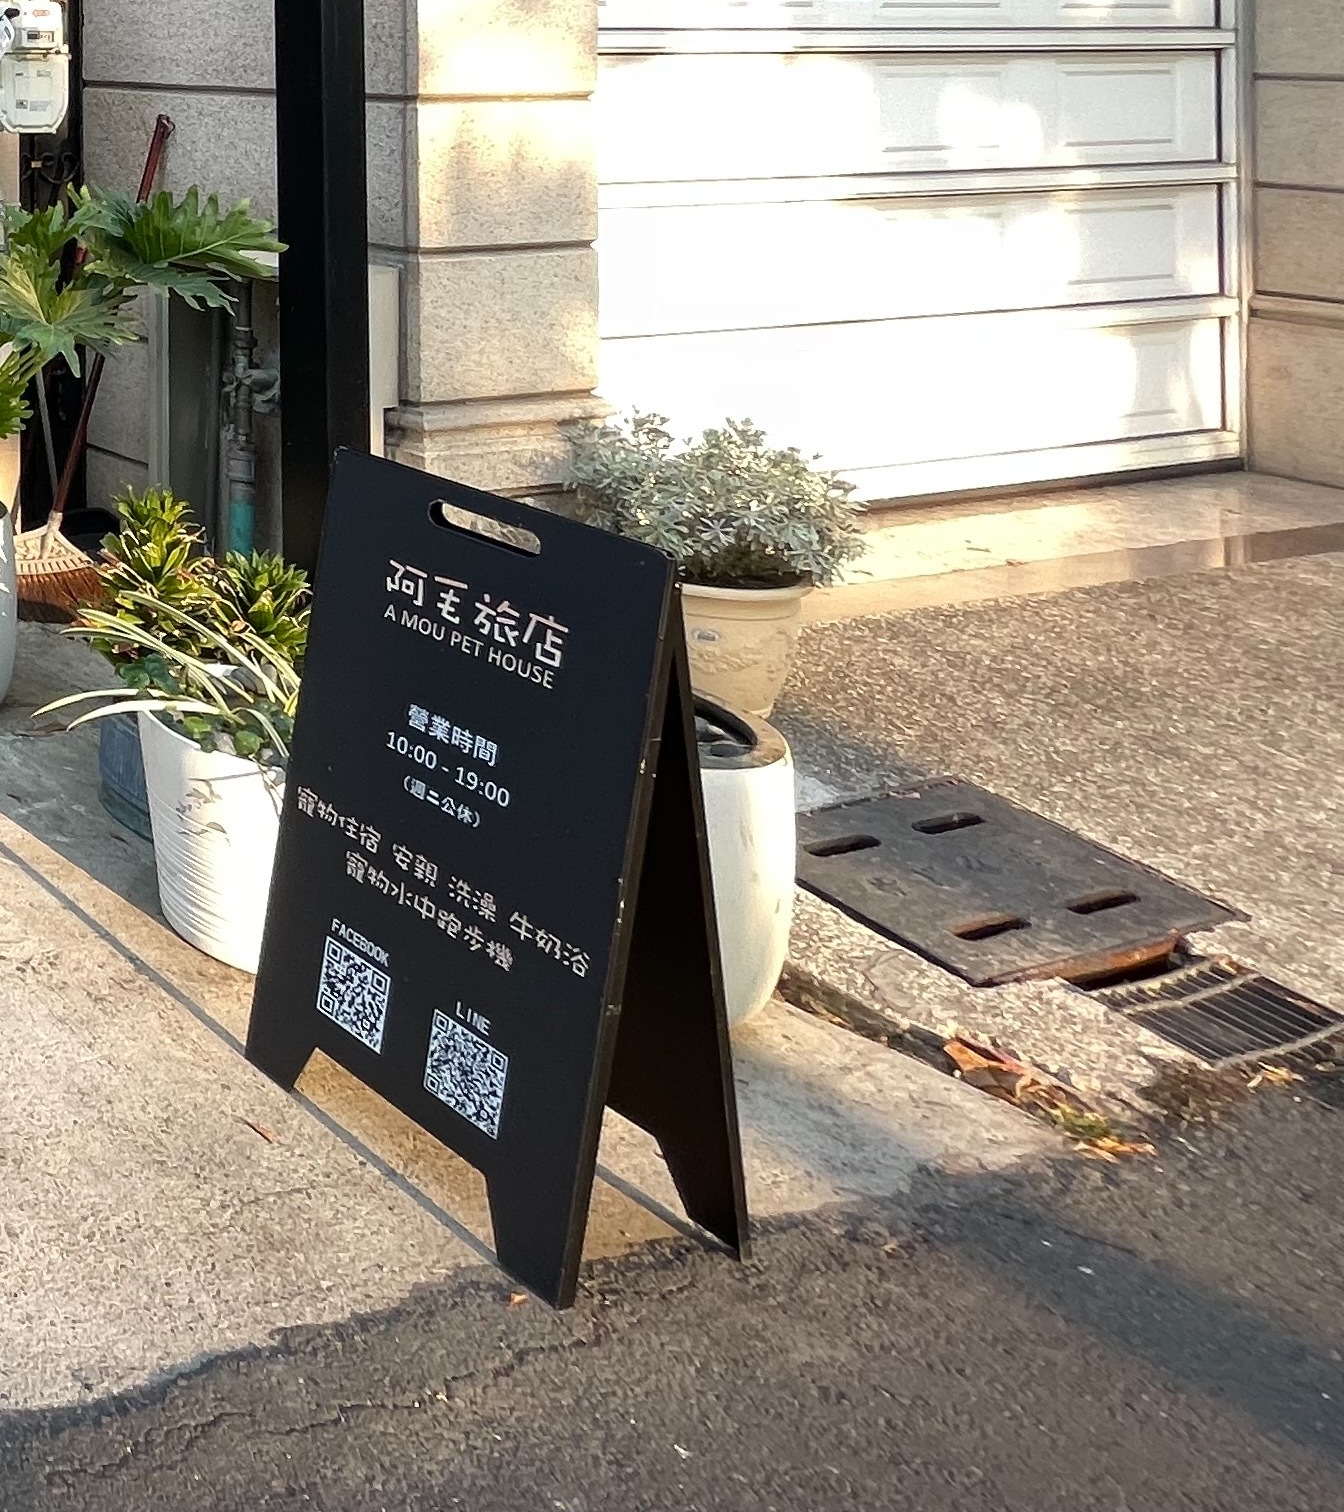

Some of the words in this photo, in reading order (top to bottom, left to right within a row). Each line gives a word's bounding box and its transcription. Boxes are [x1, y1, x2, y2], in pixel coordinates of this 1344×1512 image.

[384, 604, 397, 622] A
[401, 609, 446, 642] MOU
[450, 629, 485, 658] PET
[487, 646, 555, 690] HOUSE
[386, 559, 570, 668] 阿毛旅店
[385, 730, 438, 770] 10:00
[454, 765, 510, 808] 19:00
[407, 702, 499, 767] 營業時間
[296, 785, 382, 854] 寵物住宿
[392, 842, 440, 888] 安親
[448, 874, 497, 923] 洗澡
[509, 911, 591, 978] 牛奶浴
[345, 849, 515, 972] 寵物水中跑步機
[330, 917, 390, 967] FACEBOOK
[456, 1000, 492, 1036] LINE
